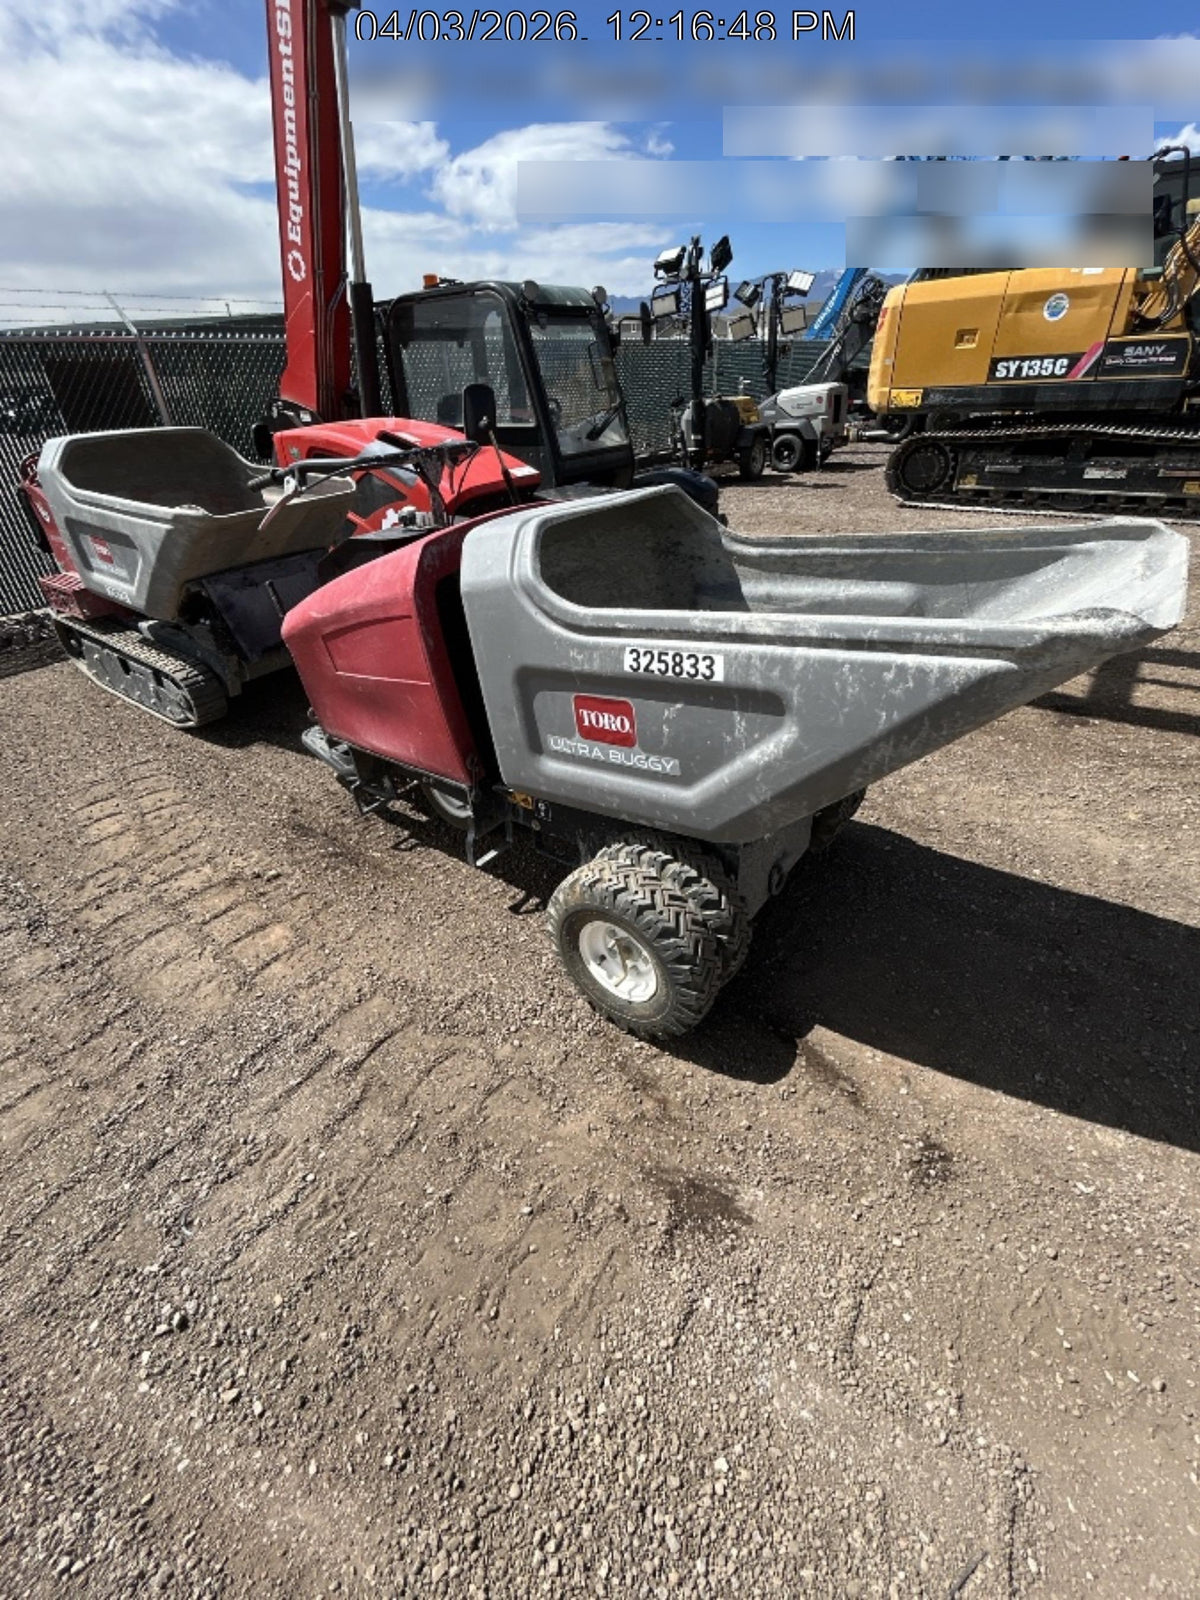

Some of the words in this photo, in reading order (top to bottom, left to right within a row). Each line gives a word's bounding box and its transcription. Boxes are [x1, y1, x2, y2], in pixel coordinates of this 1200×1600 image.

[1123, 344, 1167, 357] SANY
[995, 358, 1069, 378] SY135C
[628, 648, 716, 680] 325833
[579, 708, 631, 734] TORO
[549, 735, 605, 760] ULTRA
[608, 750, 675, 772] BUGGY
